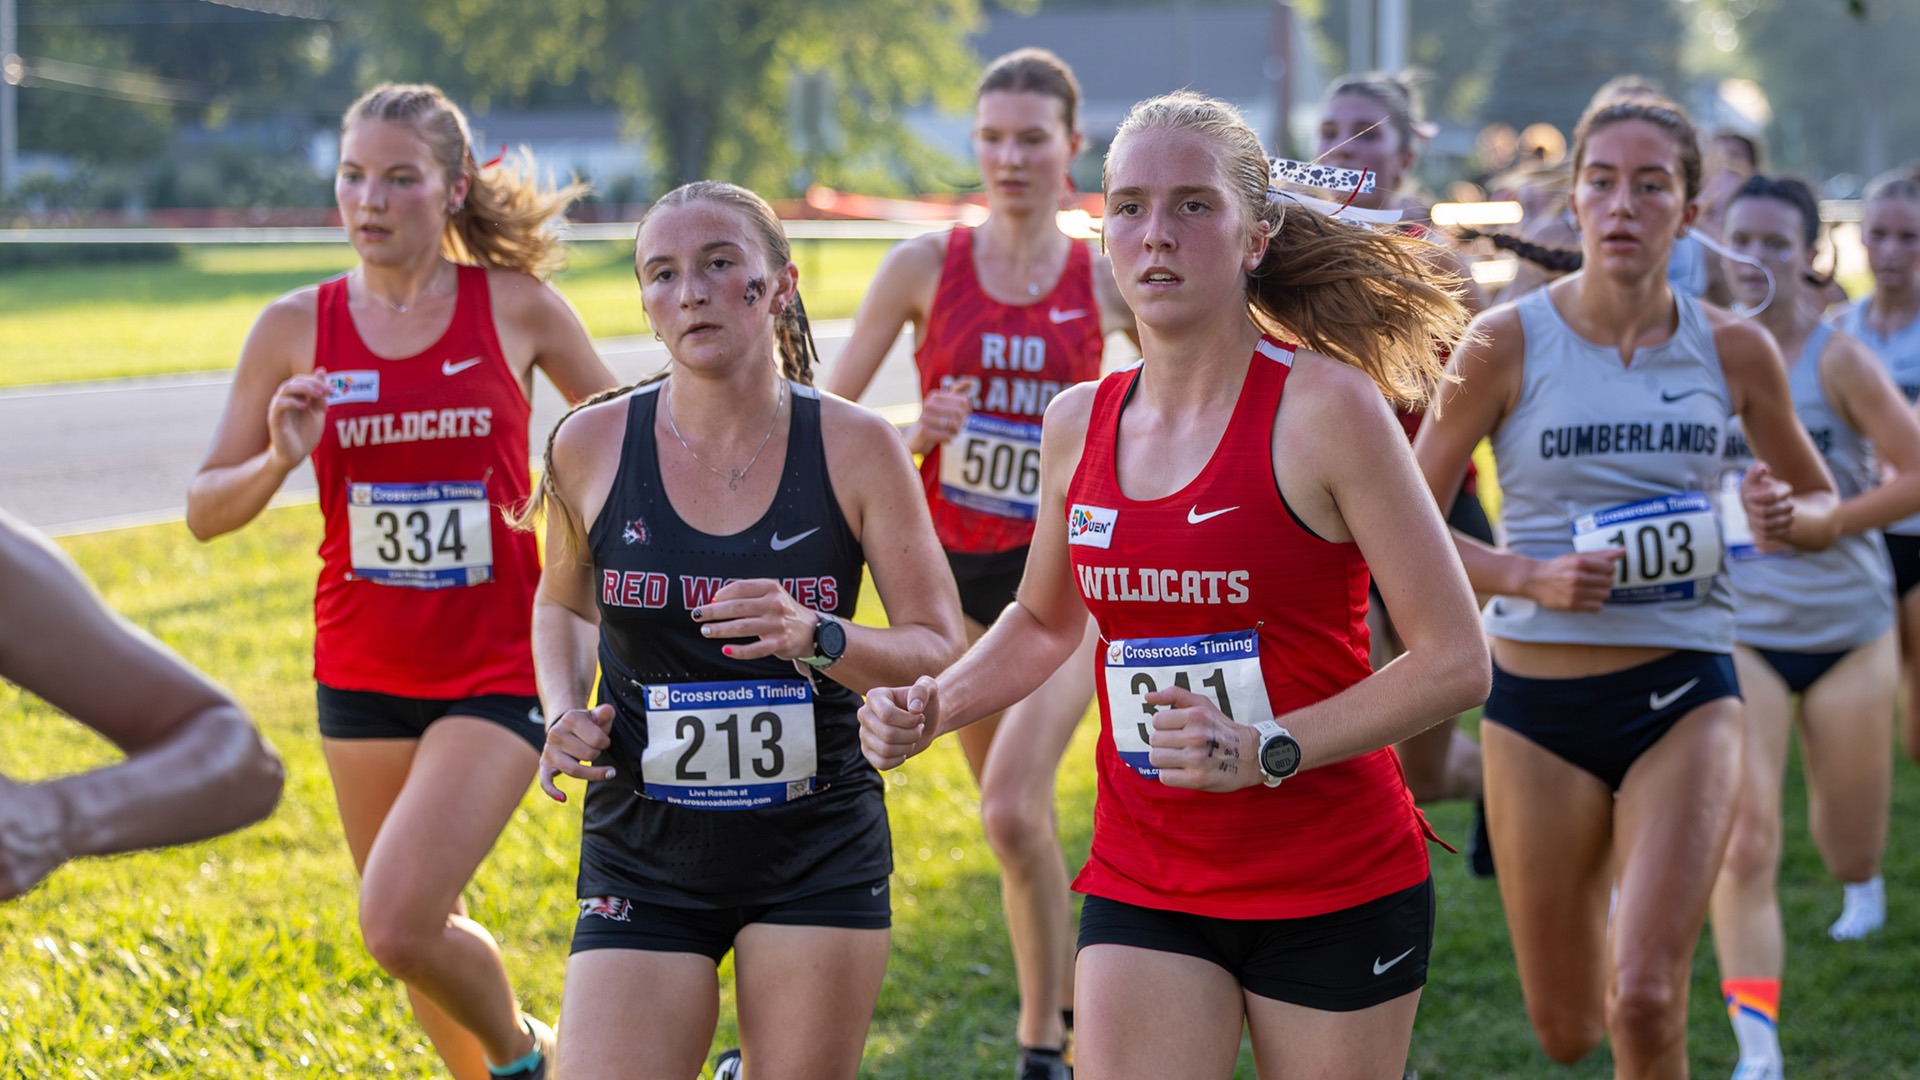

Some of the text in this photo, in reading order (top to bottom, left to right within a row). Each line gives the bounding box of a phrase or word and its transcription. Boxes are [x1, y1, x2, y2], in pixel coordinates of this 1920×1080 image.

[980, 332, 1047, 372] RIO
[336, 407, 492, 449] WILDCATS
[1541, 423, 1718, 460] CUMBERLANDS
[963, 438, 1041, 496] 506
[375, 508, 467, 565] 334
[1607, 520, 1695, 584] 103
[603, 569, 670, 609] RED
[1077, 564, 1250, 604] WILDCATS
[1124, 637, 1253, 659] Crossroads Timing
[670, 684, 807, 704] Crossroads Timing
[675, 711, 785, 781] 213
[689, 788, 748, 798] Live Results at
